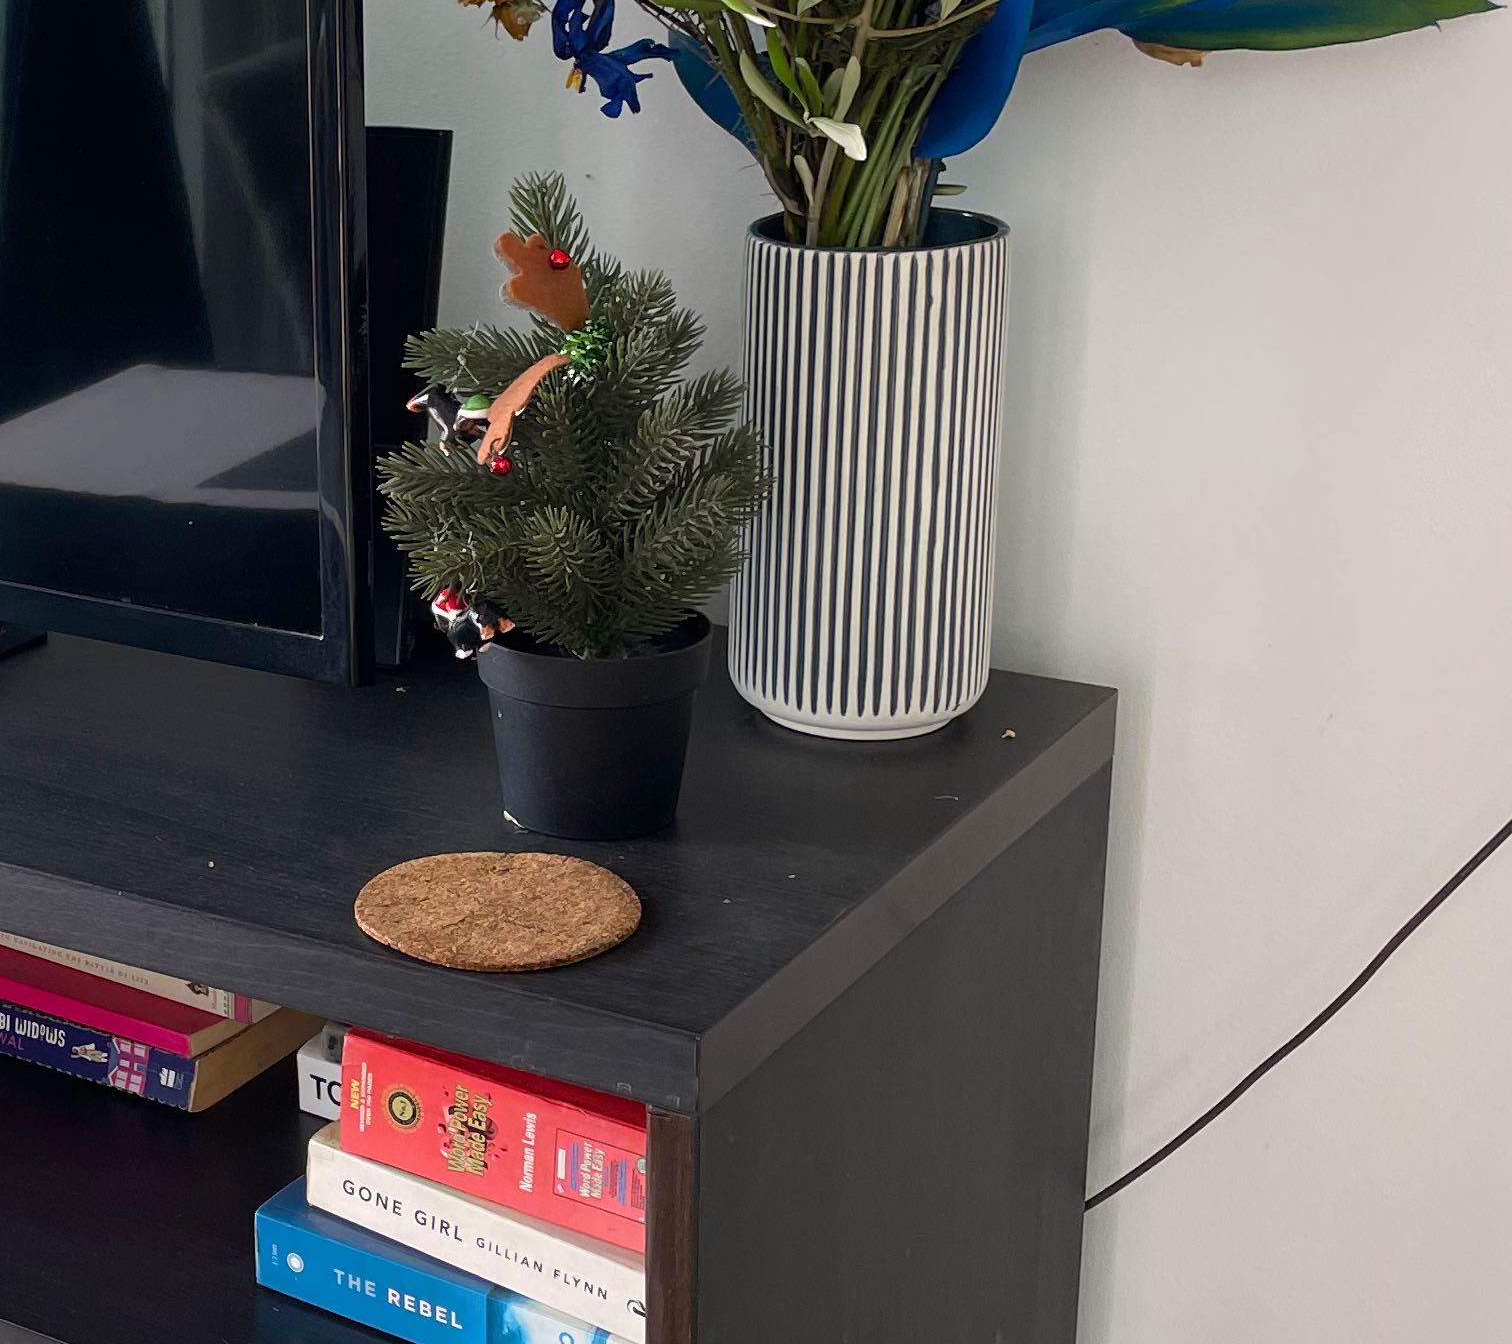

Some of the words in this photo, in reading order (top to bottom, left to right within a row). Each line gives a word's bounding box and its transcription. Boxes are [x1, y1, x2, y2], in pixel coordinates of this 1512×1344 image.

[14, 1017, 67, 1048] WIDOWS
[349, 1079, 360, 1109] NEW
[452, 1082, 470, 1131] Power
[468, 1093, 494, 1130] Easy
[521, 1112, 537, 1146] Lewis
[447, 1130, 467, 1173] Word
[464, 1131, 486, 1177] Made
[519, 1147, 535, 1193] Norman
[342, 1179, 403, 1216] GONE
[414, 1209, 463, 1242] GIRL
[476, 1237, 543, 1273] GILLIAN
[553, 1268, 608, 1300] FLYNN
[333, 1268, 377, 1298] THE
[388, 1288, 463, 1330] REBEL
